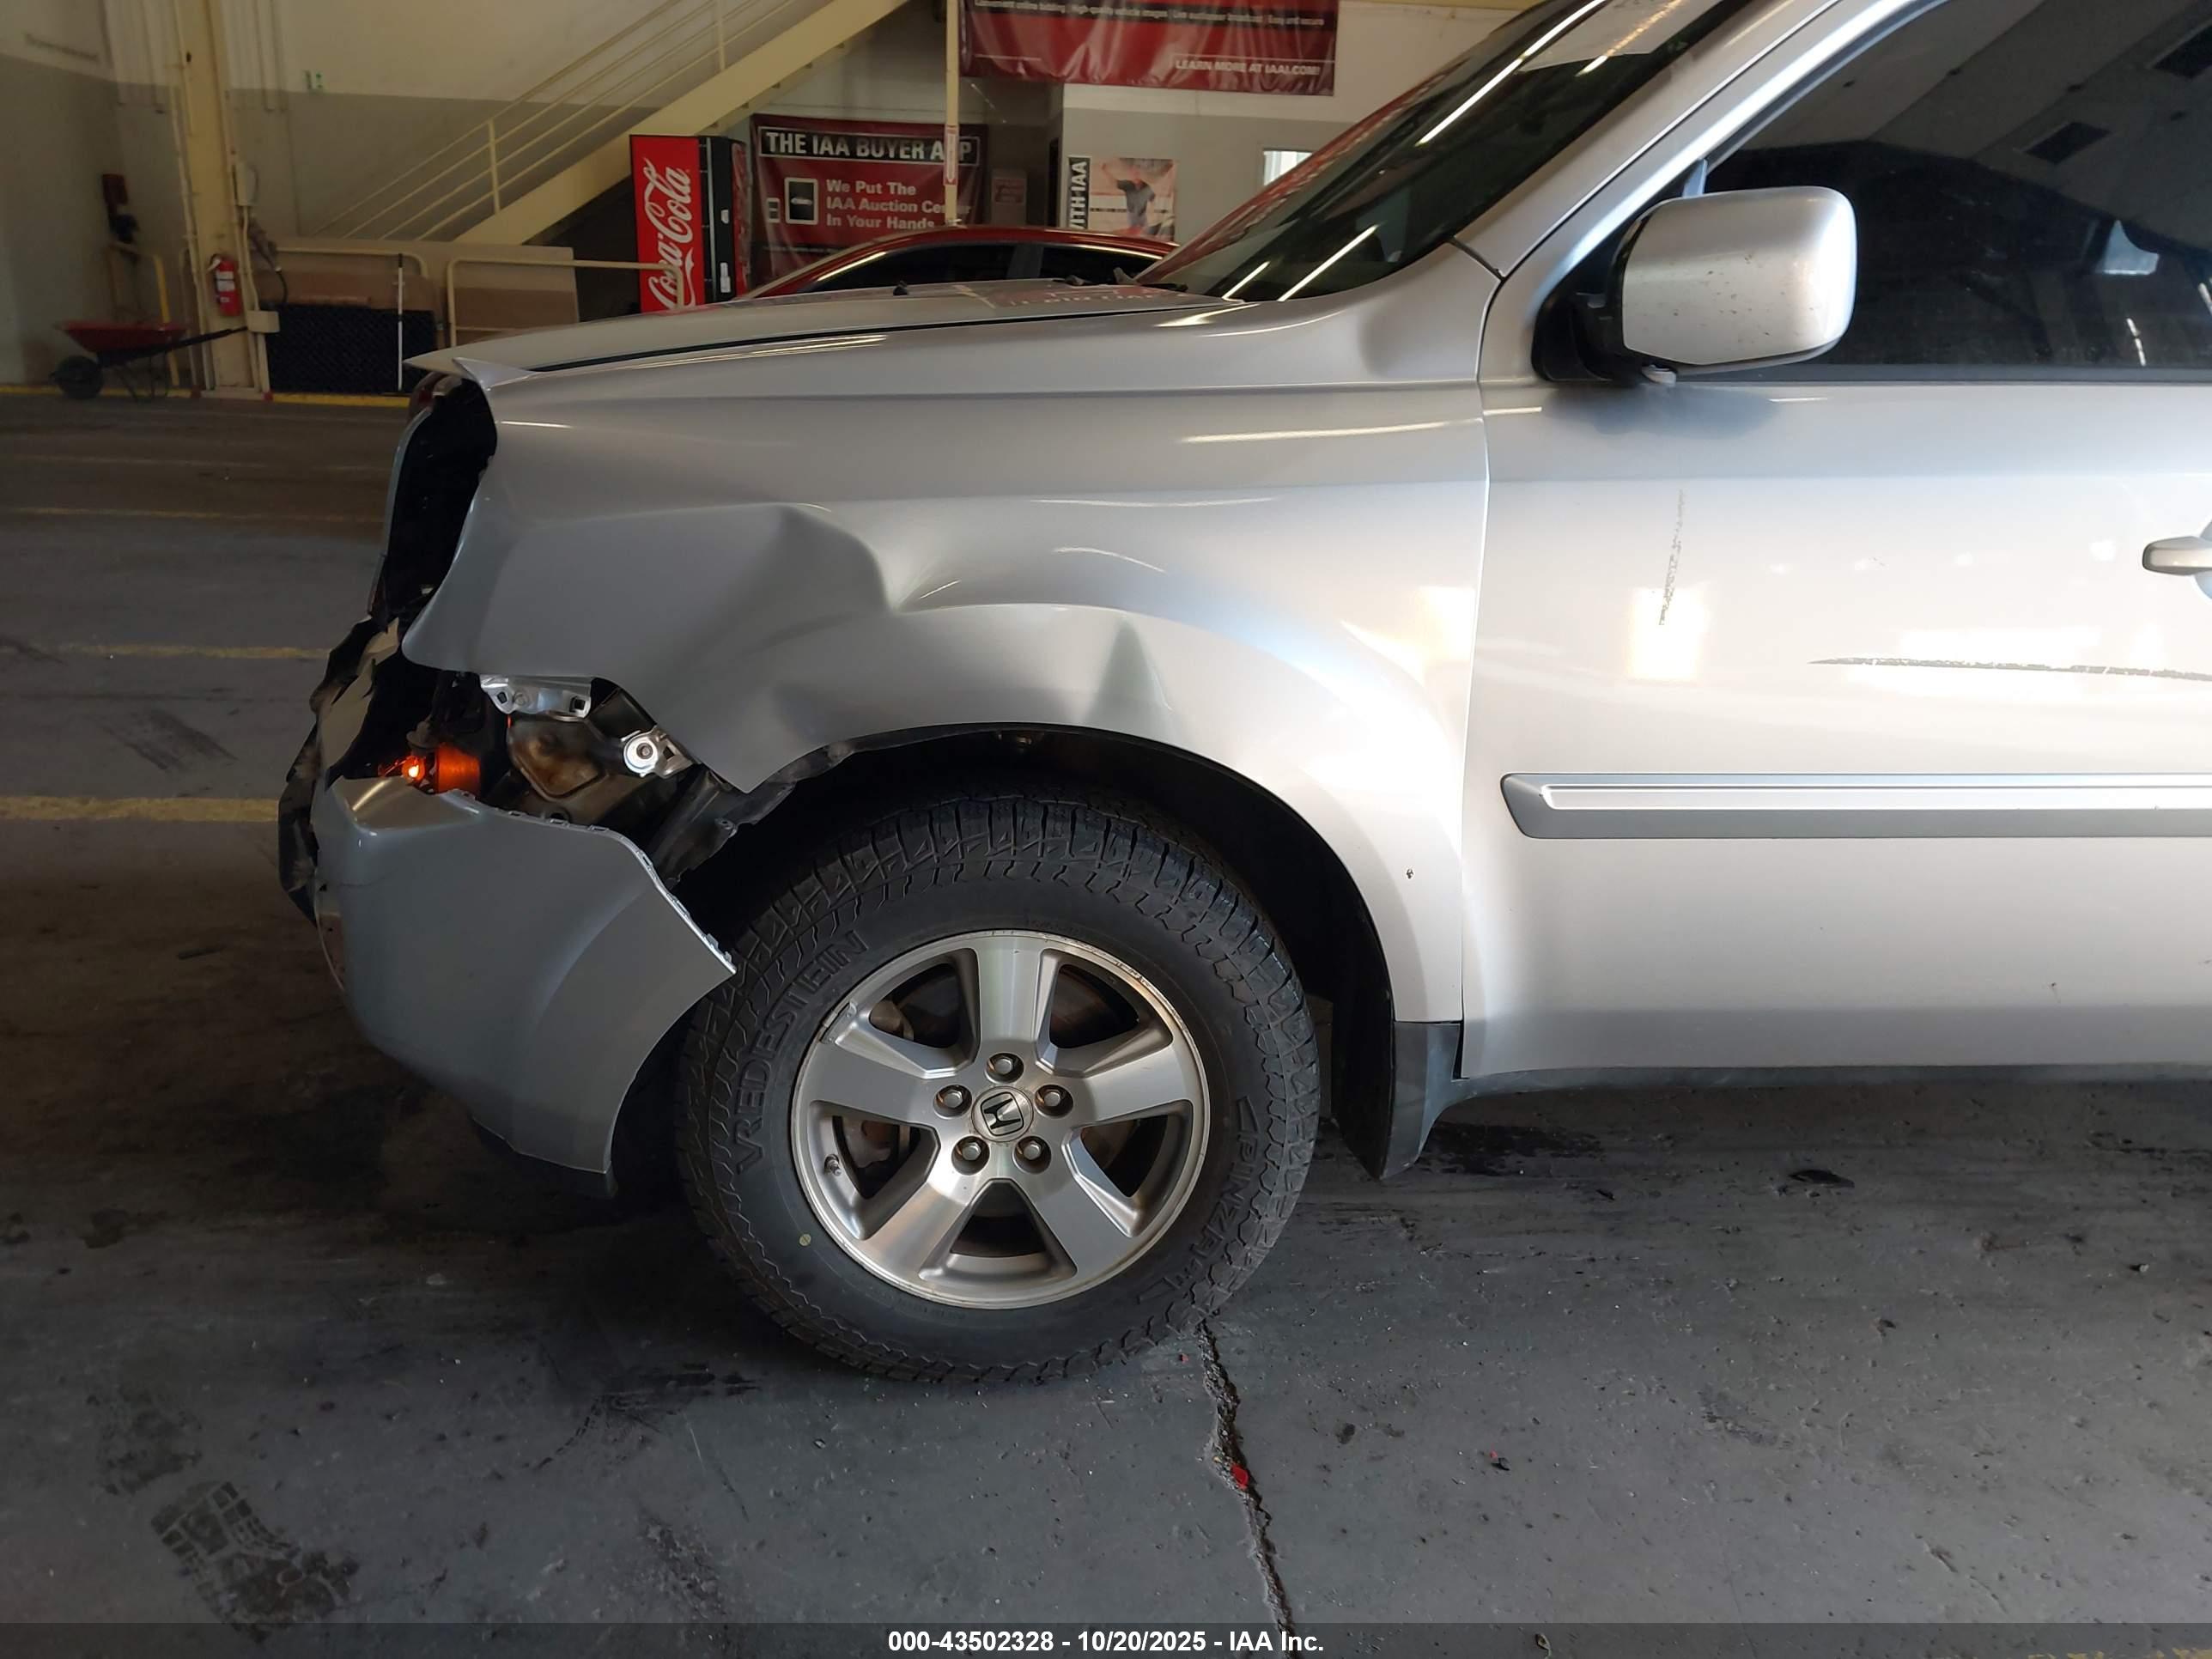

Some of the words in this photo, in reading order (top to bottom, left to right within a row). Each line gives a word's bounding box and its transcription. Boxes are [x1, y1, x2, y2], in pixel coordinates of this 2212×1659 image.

[1176, 59, 1212, 70] LEARN
[1214, 61, 1246, 73] MORE
[1249, 63, 1262, 74] AT
[766, 131, 806, 154] THE
[812, 136, 850, 157] IAA
[856, 138, 925, 160] BUYER
[930, 140, 972, 161] AP
[1071, 161, 1087, 191] IAA
[826, 179, 850, 193] We
[855, 180, 883, 195] Put
[887, 182, 917, 196] The
[827, 197, 855, 210] IAA
[859, 198, 918, 213] Auction
[827, 216, 842, 227] In
[847, 216, 882, 228] Your
[735, 929, 869, 1175] VREDESTEIN
